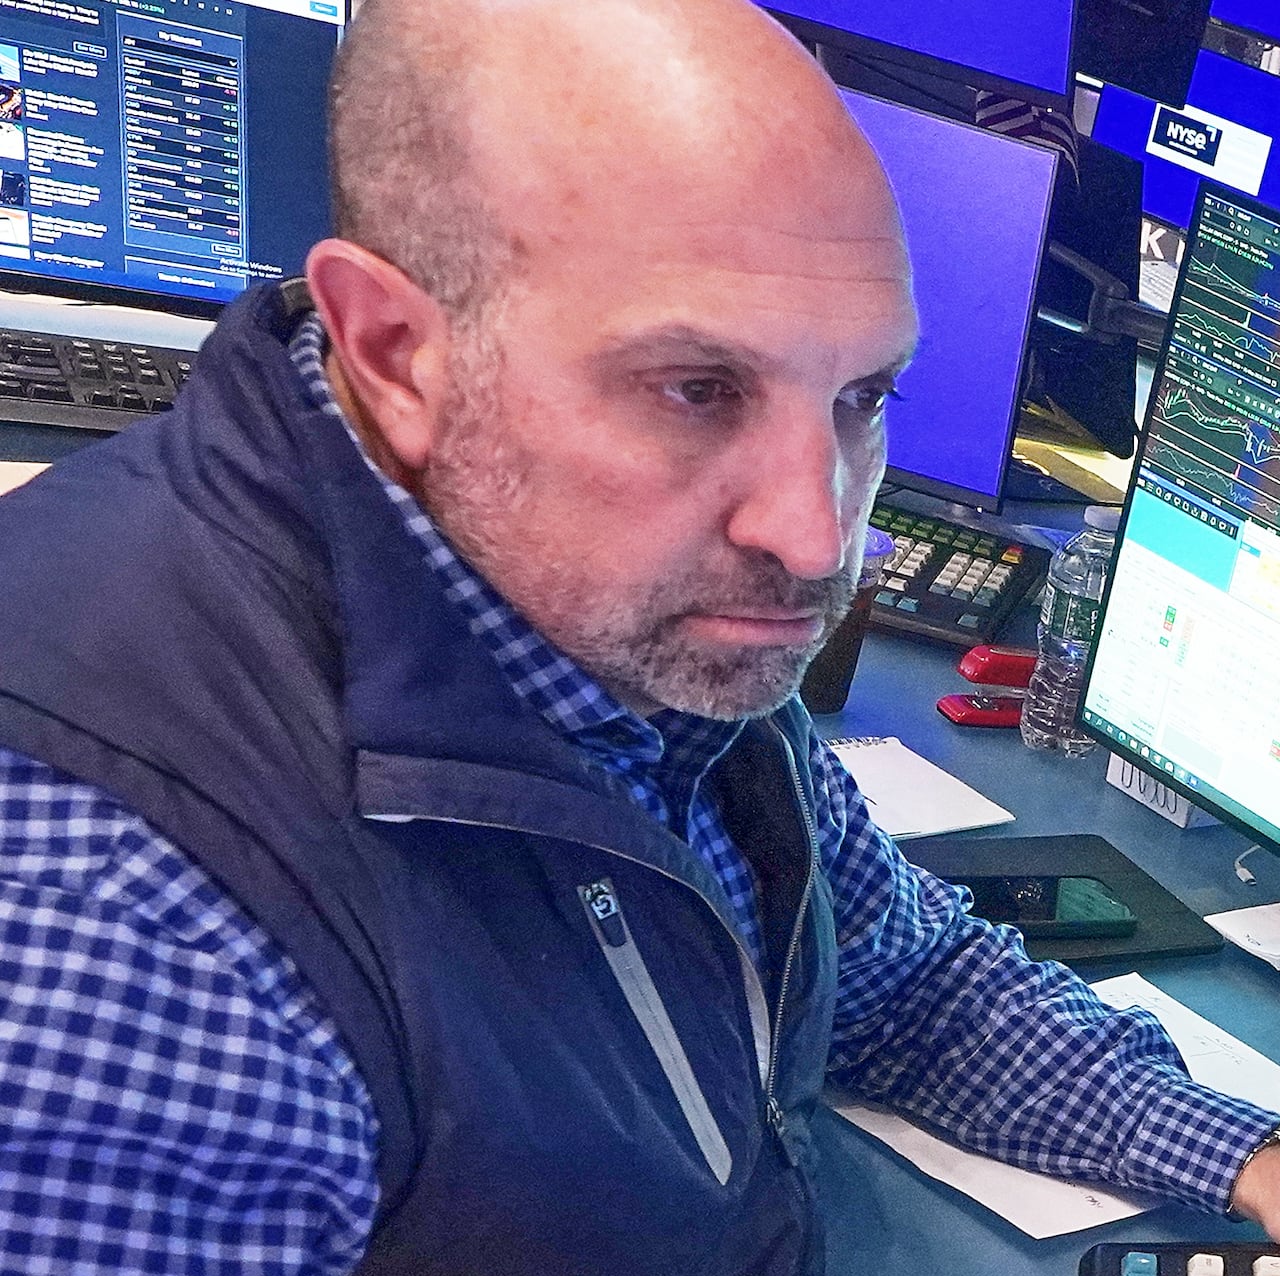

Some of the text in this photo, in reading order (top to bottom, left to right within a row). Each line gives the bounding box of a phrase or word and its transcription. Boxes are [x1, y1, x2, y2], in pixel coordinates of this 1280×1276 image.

[1166, 121, 1207, 151] NYSE
[219, 257, 282, 274] Activate Windows
